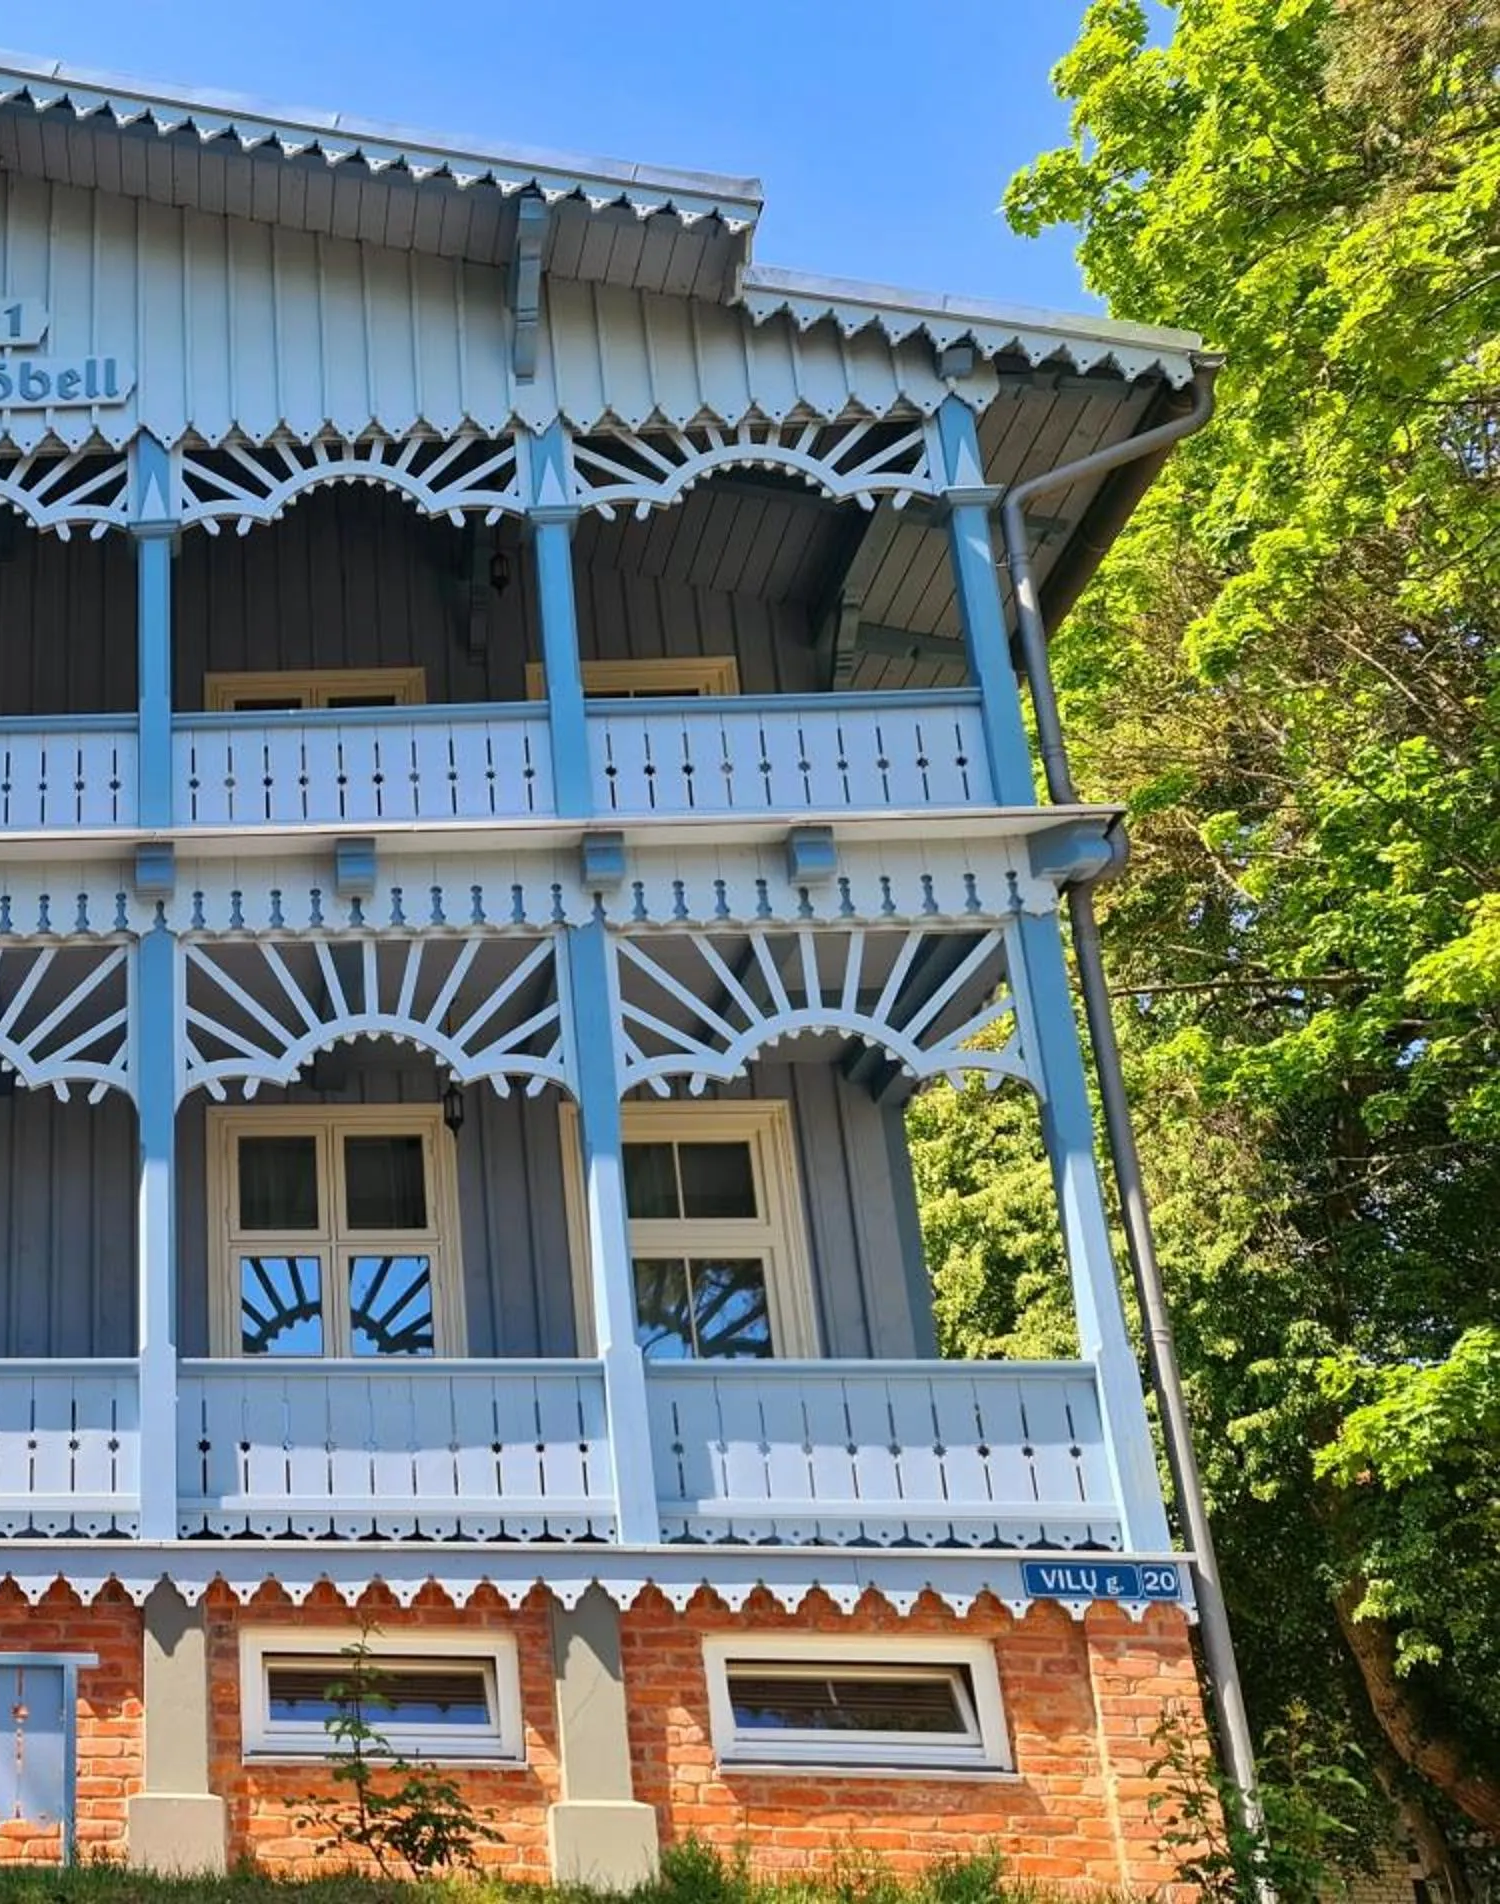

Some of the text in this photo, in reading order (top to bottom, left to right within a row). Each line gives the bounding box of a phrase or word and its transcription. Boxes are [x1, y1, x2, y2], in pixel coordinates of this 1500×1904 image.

[1040, 1568, 1124, 1595] VILŲ g.
[1144, 1571, 1175, 1591] 20
